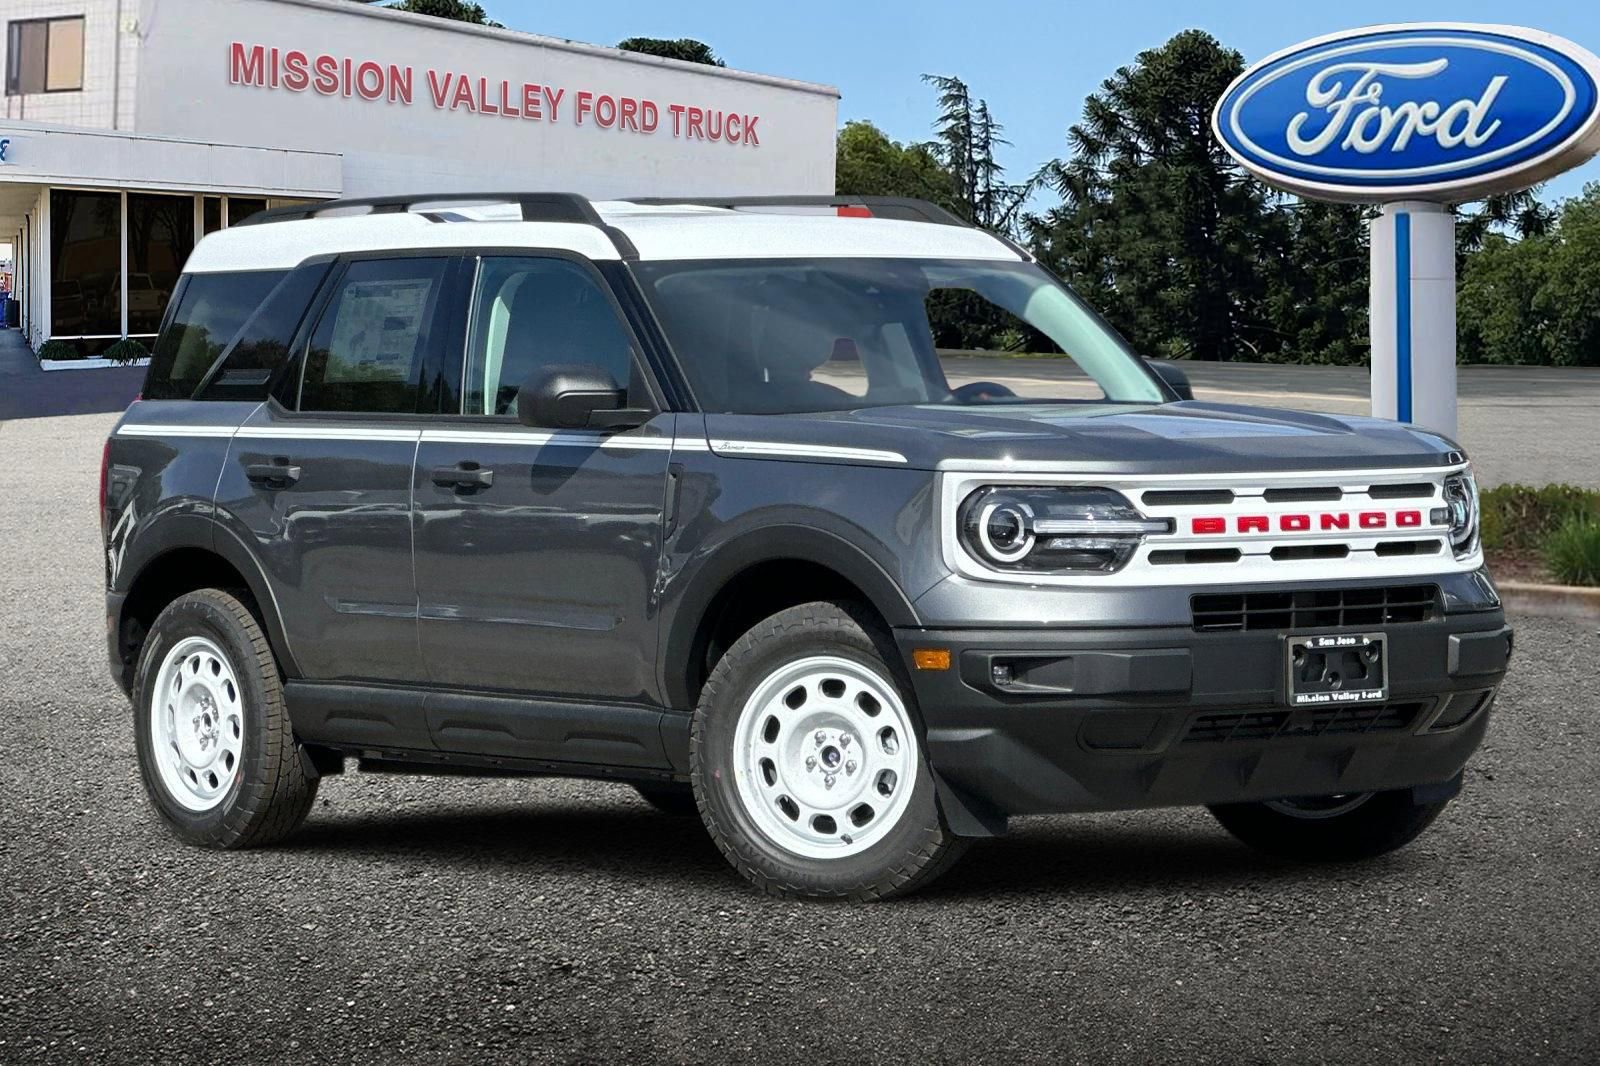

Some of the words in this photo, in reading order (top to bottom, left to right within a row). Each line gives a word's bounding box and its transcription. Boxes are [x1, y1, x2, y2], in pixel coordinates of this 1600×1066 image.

[230, 41, 414, 105] MISSION
[426, 69, 565, 122] VALLEY
[575, 90, 660, 134] FORD
[669, 103, 761, 146] TRUCK
[1286, 58, 1509, 156] Ford
[1191, 510, 1422, 534] BRONCO
[1318, 637, 1335, 647] San
[1331, 692, 1360, 701] Valley
[1361, 690, 1382, 699] Ford
